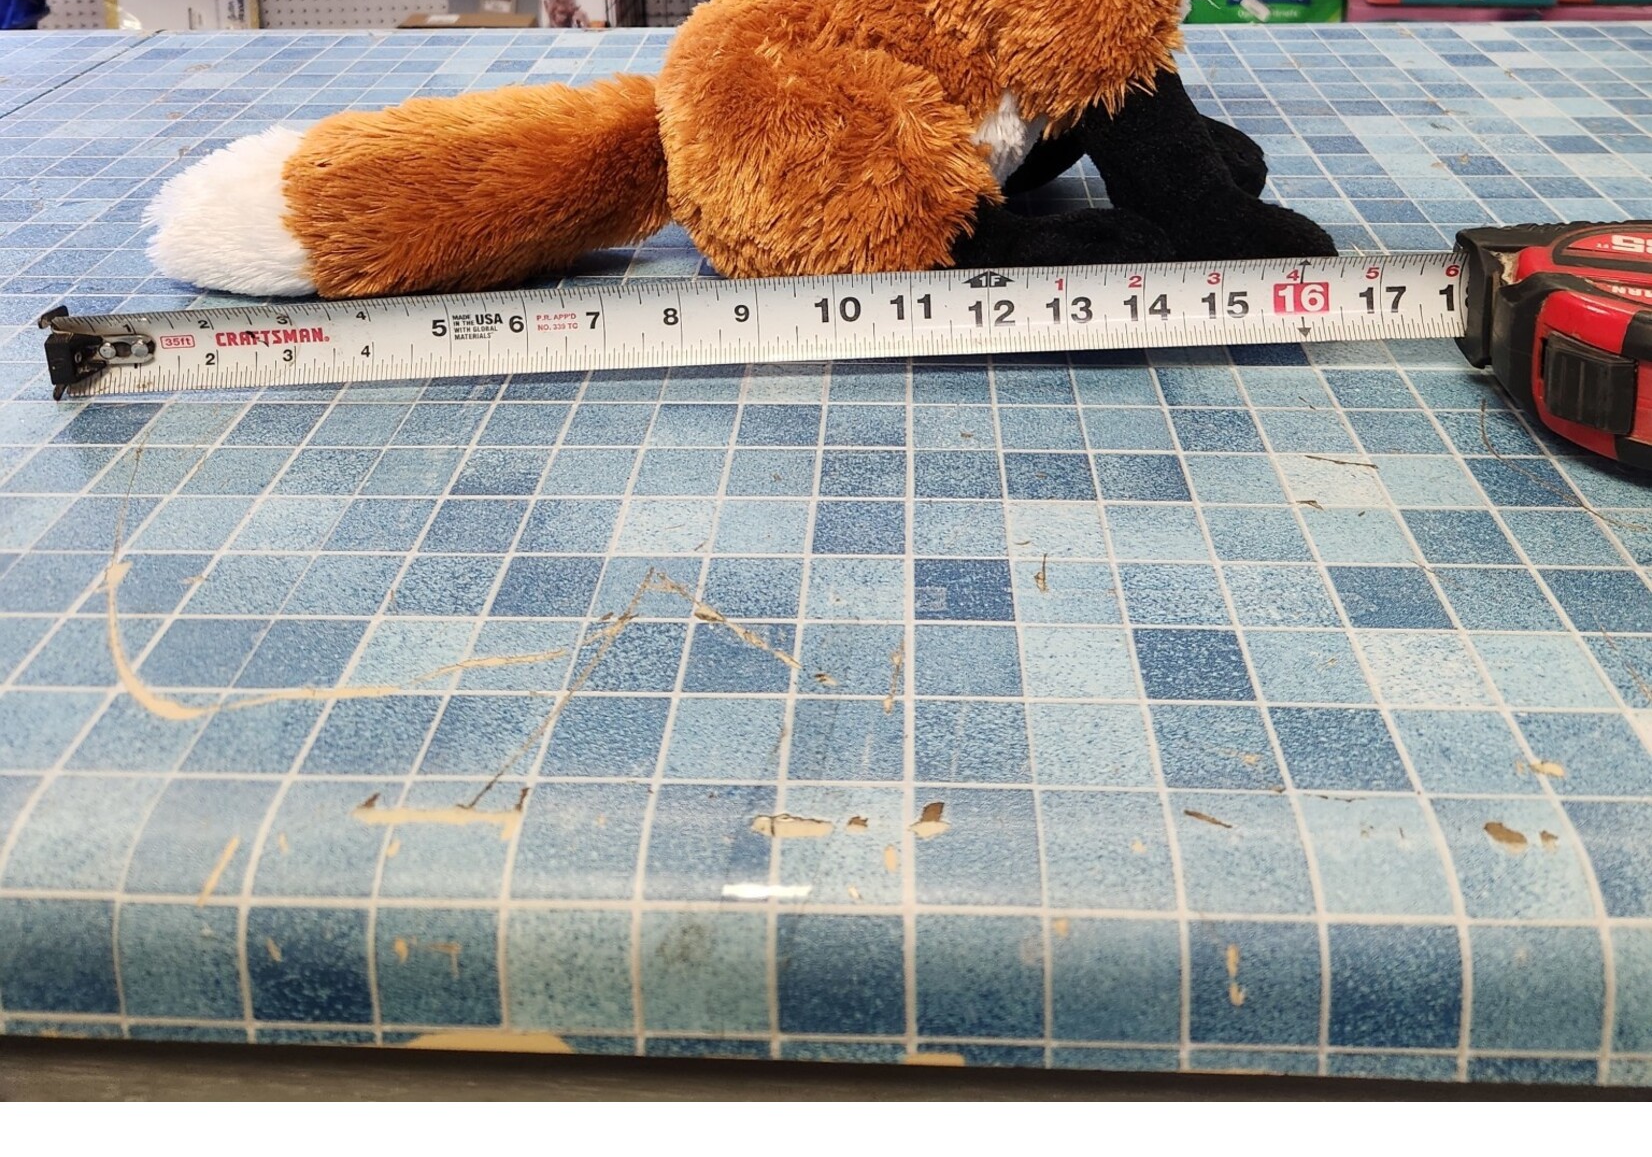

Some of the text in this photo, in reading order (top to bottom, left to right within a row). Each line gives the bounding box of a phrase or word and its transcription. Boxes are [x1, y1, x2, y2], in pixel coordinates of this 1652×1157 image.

[1054, 265, 1460, 291] 1 2 3 4 5 6
[197, 319, 211, 329] 2
[276, 315, 288, 325] 3
[355, 310, 368, 321] 4
[431, 319, 448, 337] 5
[508, 315, 524, 333] 6
[585, 311, 600, 330] 7
[663, 307, 679, 325] 8
[734, 304, 750, 322] 9
[814, 296, 862, 323] 10
[890, 294, 933, 321] 11
[968, 299, 1016, 327] 12
[1046, 296, 1094, 324] 13
[1123, 293, 1171, 321] 14
[1201, 291, 1250, 319] 15
[1277, 283, 1326, 313] 16
[1359, 285, 1407, 314] 17
[475, 313, 503, 326] USA
[164, 327, 325, 347] 35ft CRAFTSMAN
[454, 332, 492, 341] MATERIALS
[473, 325, 499, 333] GLOBAL
[204, 345, 371, 366] 2 3 4
